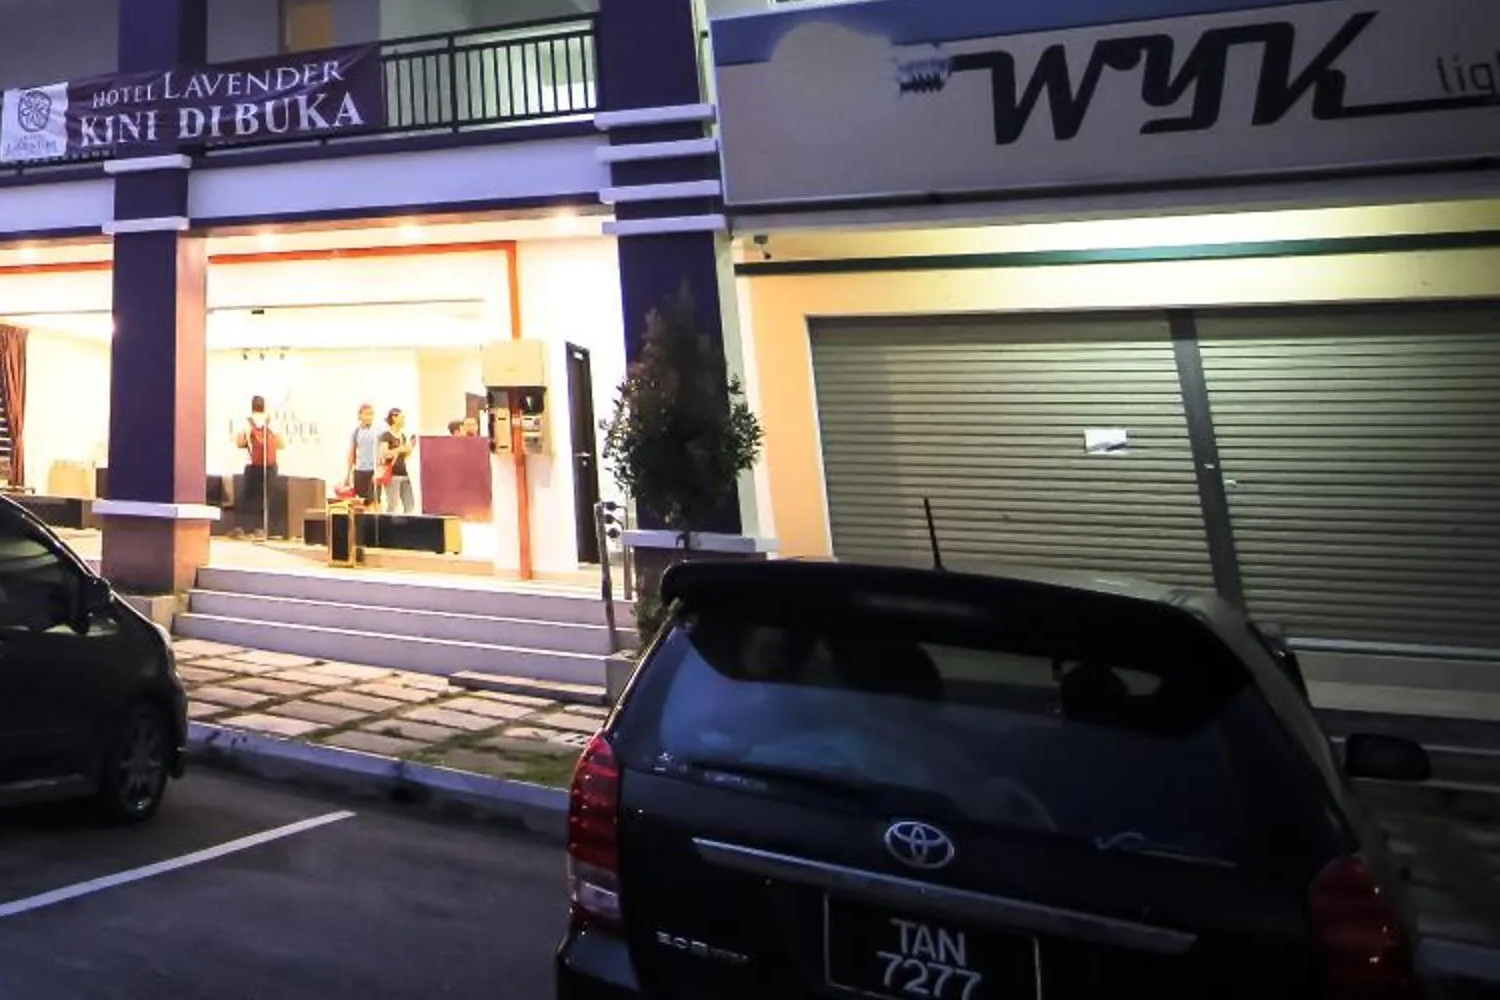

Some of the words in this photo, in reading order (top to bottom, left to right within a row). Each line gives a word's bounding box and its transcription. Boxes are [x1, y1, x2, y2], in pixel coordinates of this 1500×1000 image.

[92, 83, 157, 110] HOTEL
[163, 60, 345, 100] LAVENDER
[1436, 49, 1500, 99] lig
[77, 109, 159, 147] KINI
[888, 916, 966, 967] TAN
[876, 950, 984, 1000] 7277
